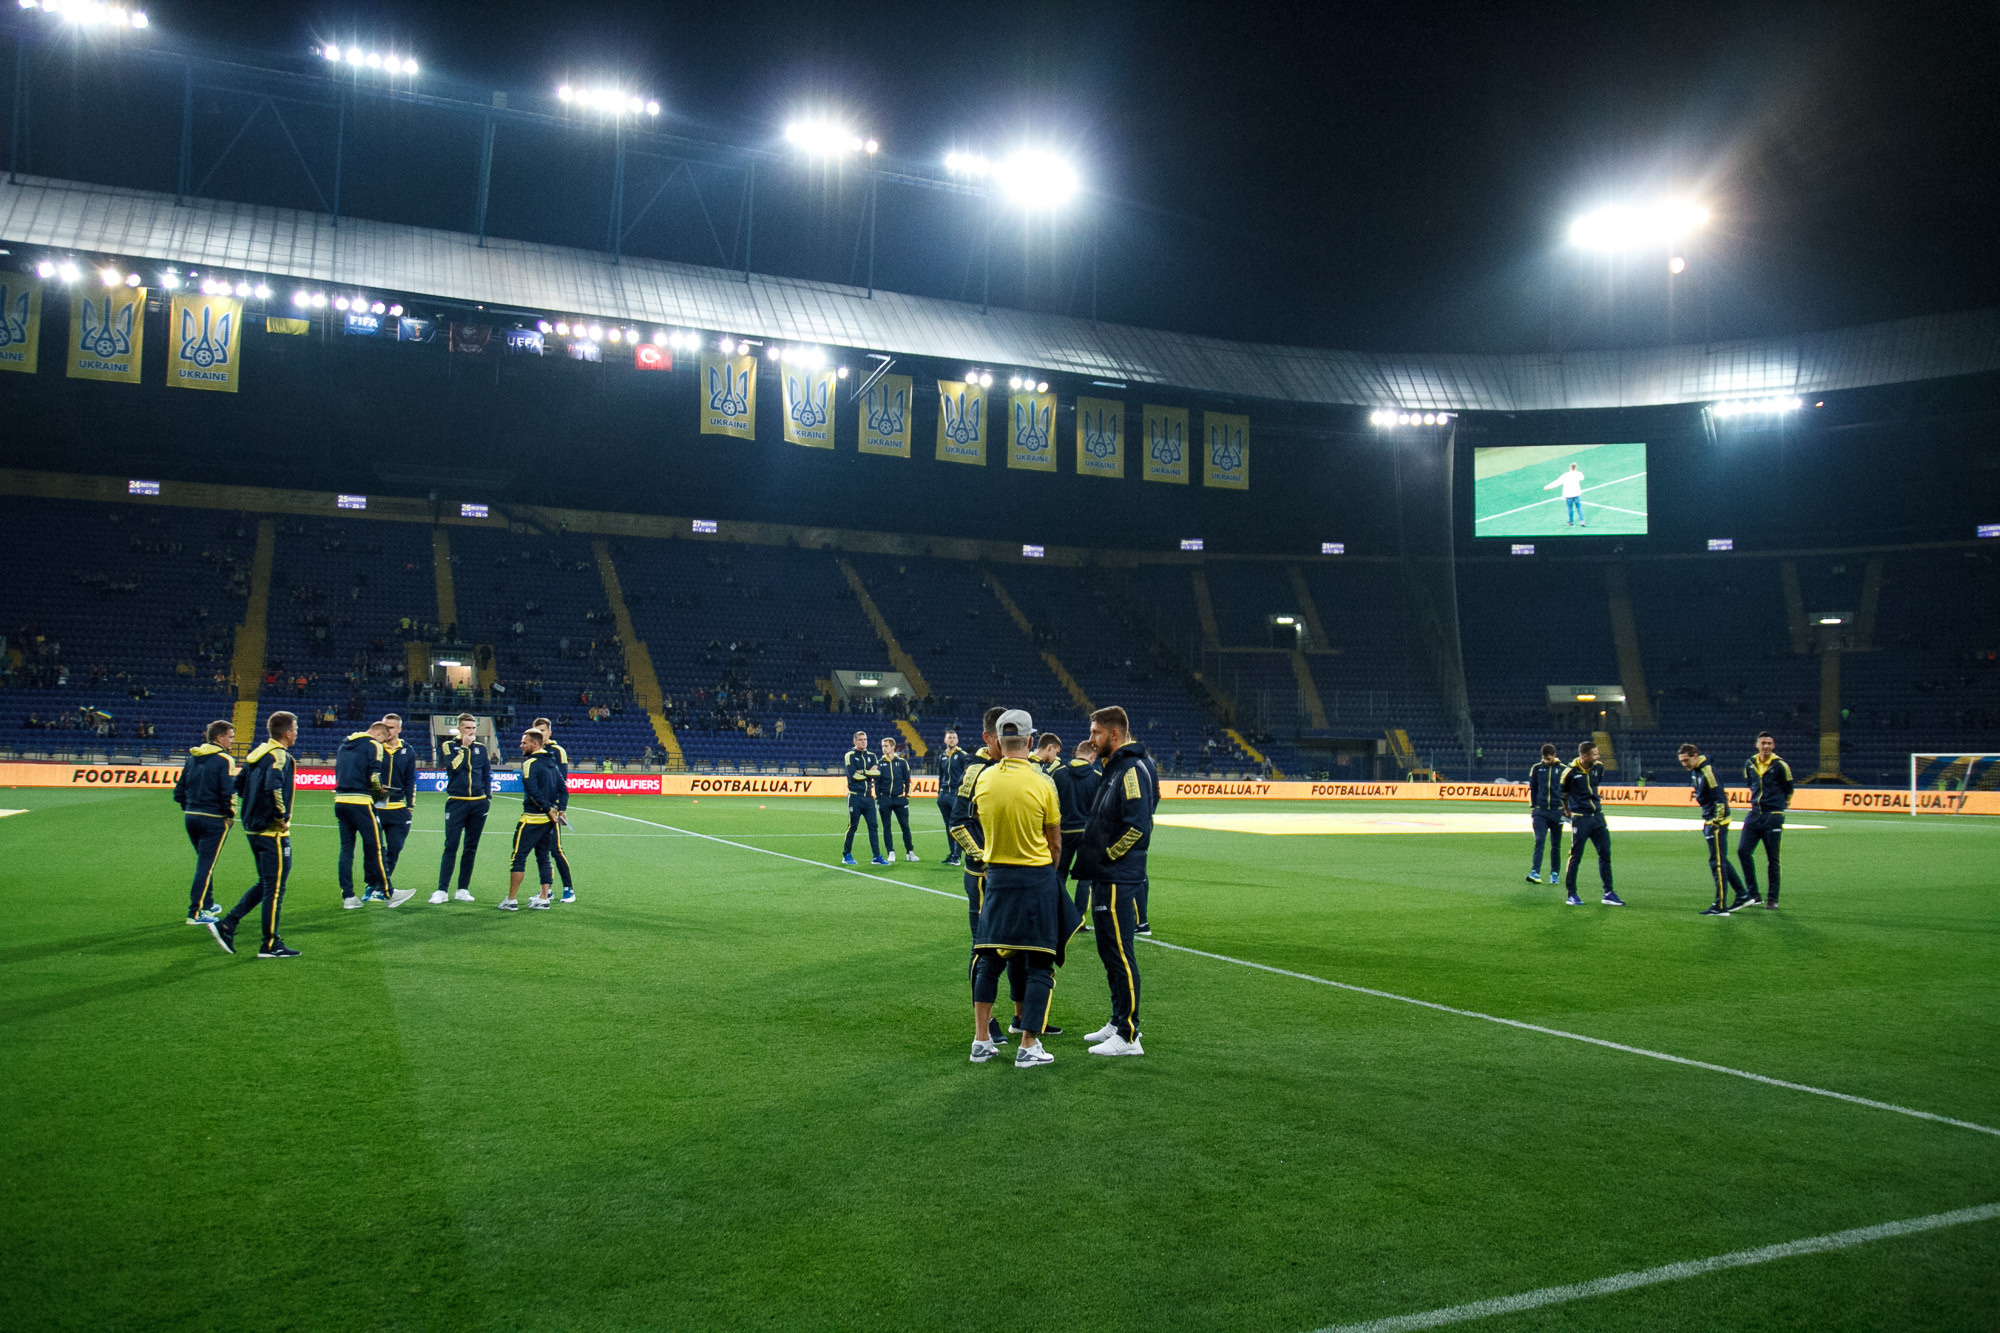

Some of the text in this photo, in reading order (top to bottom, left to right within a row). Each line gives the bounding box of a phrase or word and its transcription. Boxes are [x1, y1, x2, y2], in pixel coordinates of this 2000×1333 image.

[349, 315, 379, 328] FIFA
[507, 336, 541, 348] UEFA
[0, 351, 25, 362] AINE
[78, 359, 130, 372] UKRAINE
[178, 369, 228, 382] UKRAINE
[709, 418, 749, 430] UKRAINE
[791, 428, 828, 440] UKRAINE
[867, 438, 904, 448] UKRAINE
[944, 446, 980, 456] UKRAINE
[1016, 453, 1050, 463] UKRAINE
[1085, 460, 1117, 470] UKRAINE
[1150, 467, 1182, 476] UKRAINE
[1211, 473, 1243, 482] UKRAINE
[129, 480, 140, 488] 24
[72, 769, 182, 784] FOOTBALLU
[295, 774, 336, 785] ROPEAN
[419, 772, 436, 780] 2018
[566, 778, 660, 790] ROPEAN QUALIFIERS
[690, 779, 813, 793] FOOTBALLUA.TV
[1176, 784, 1271, 795] FOOTBALLUA.TV
[1311, 785, 1399, 796] FOOTBALLUA.TV
[1439, 786, 1531, 798] FOOTBALLUA.TV
[1599, 789, 1649, 801] ALLUA.TV
